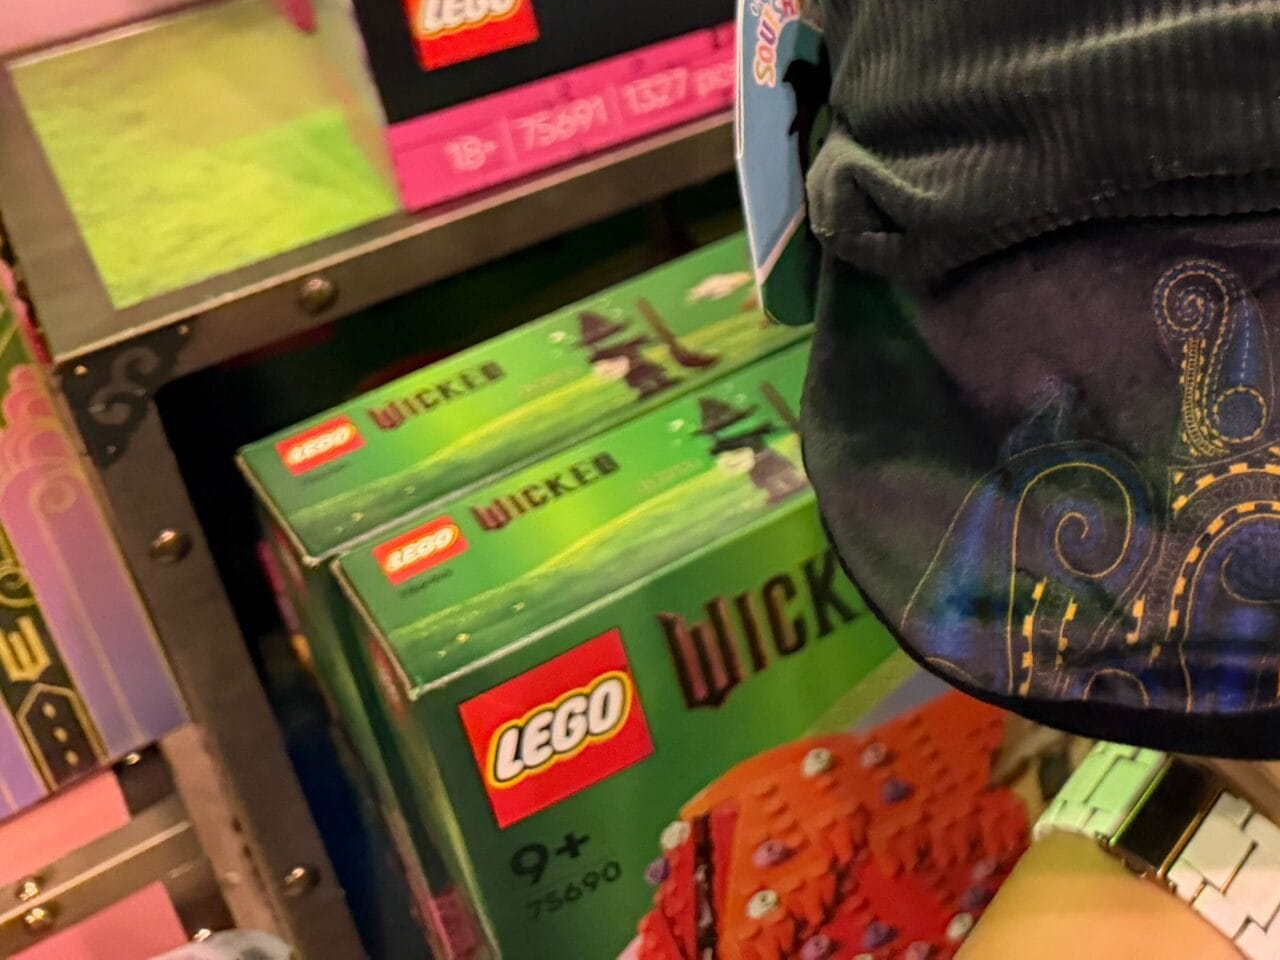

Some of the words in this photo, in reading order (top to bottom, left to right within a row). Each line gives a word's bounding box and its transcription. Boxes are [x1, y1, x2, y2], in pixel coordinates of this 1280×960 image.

[367, 360, 506, 430] WICKED
[286, 424, 353, 465] LEGO
[470, 451, 620, 532] WICKED
[386, 525, 457, 571] LEGO
[656, 549, 858, 710] WICK
[494, 676, 626, 782] LEGO
[510, 831, 591, 887] 9+
[525, 860, 622, 919] 75690
